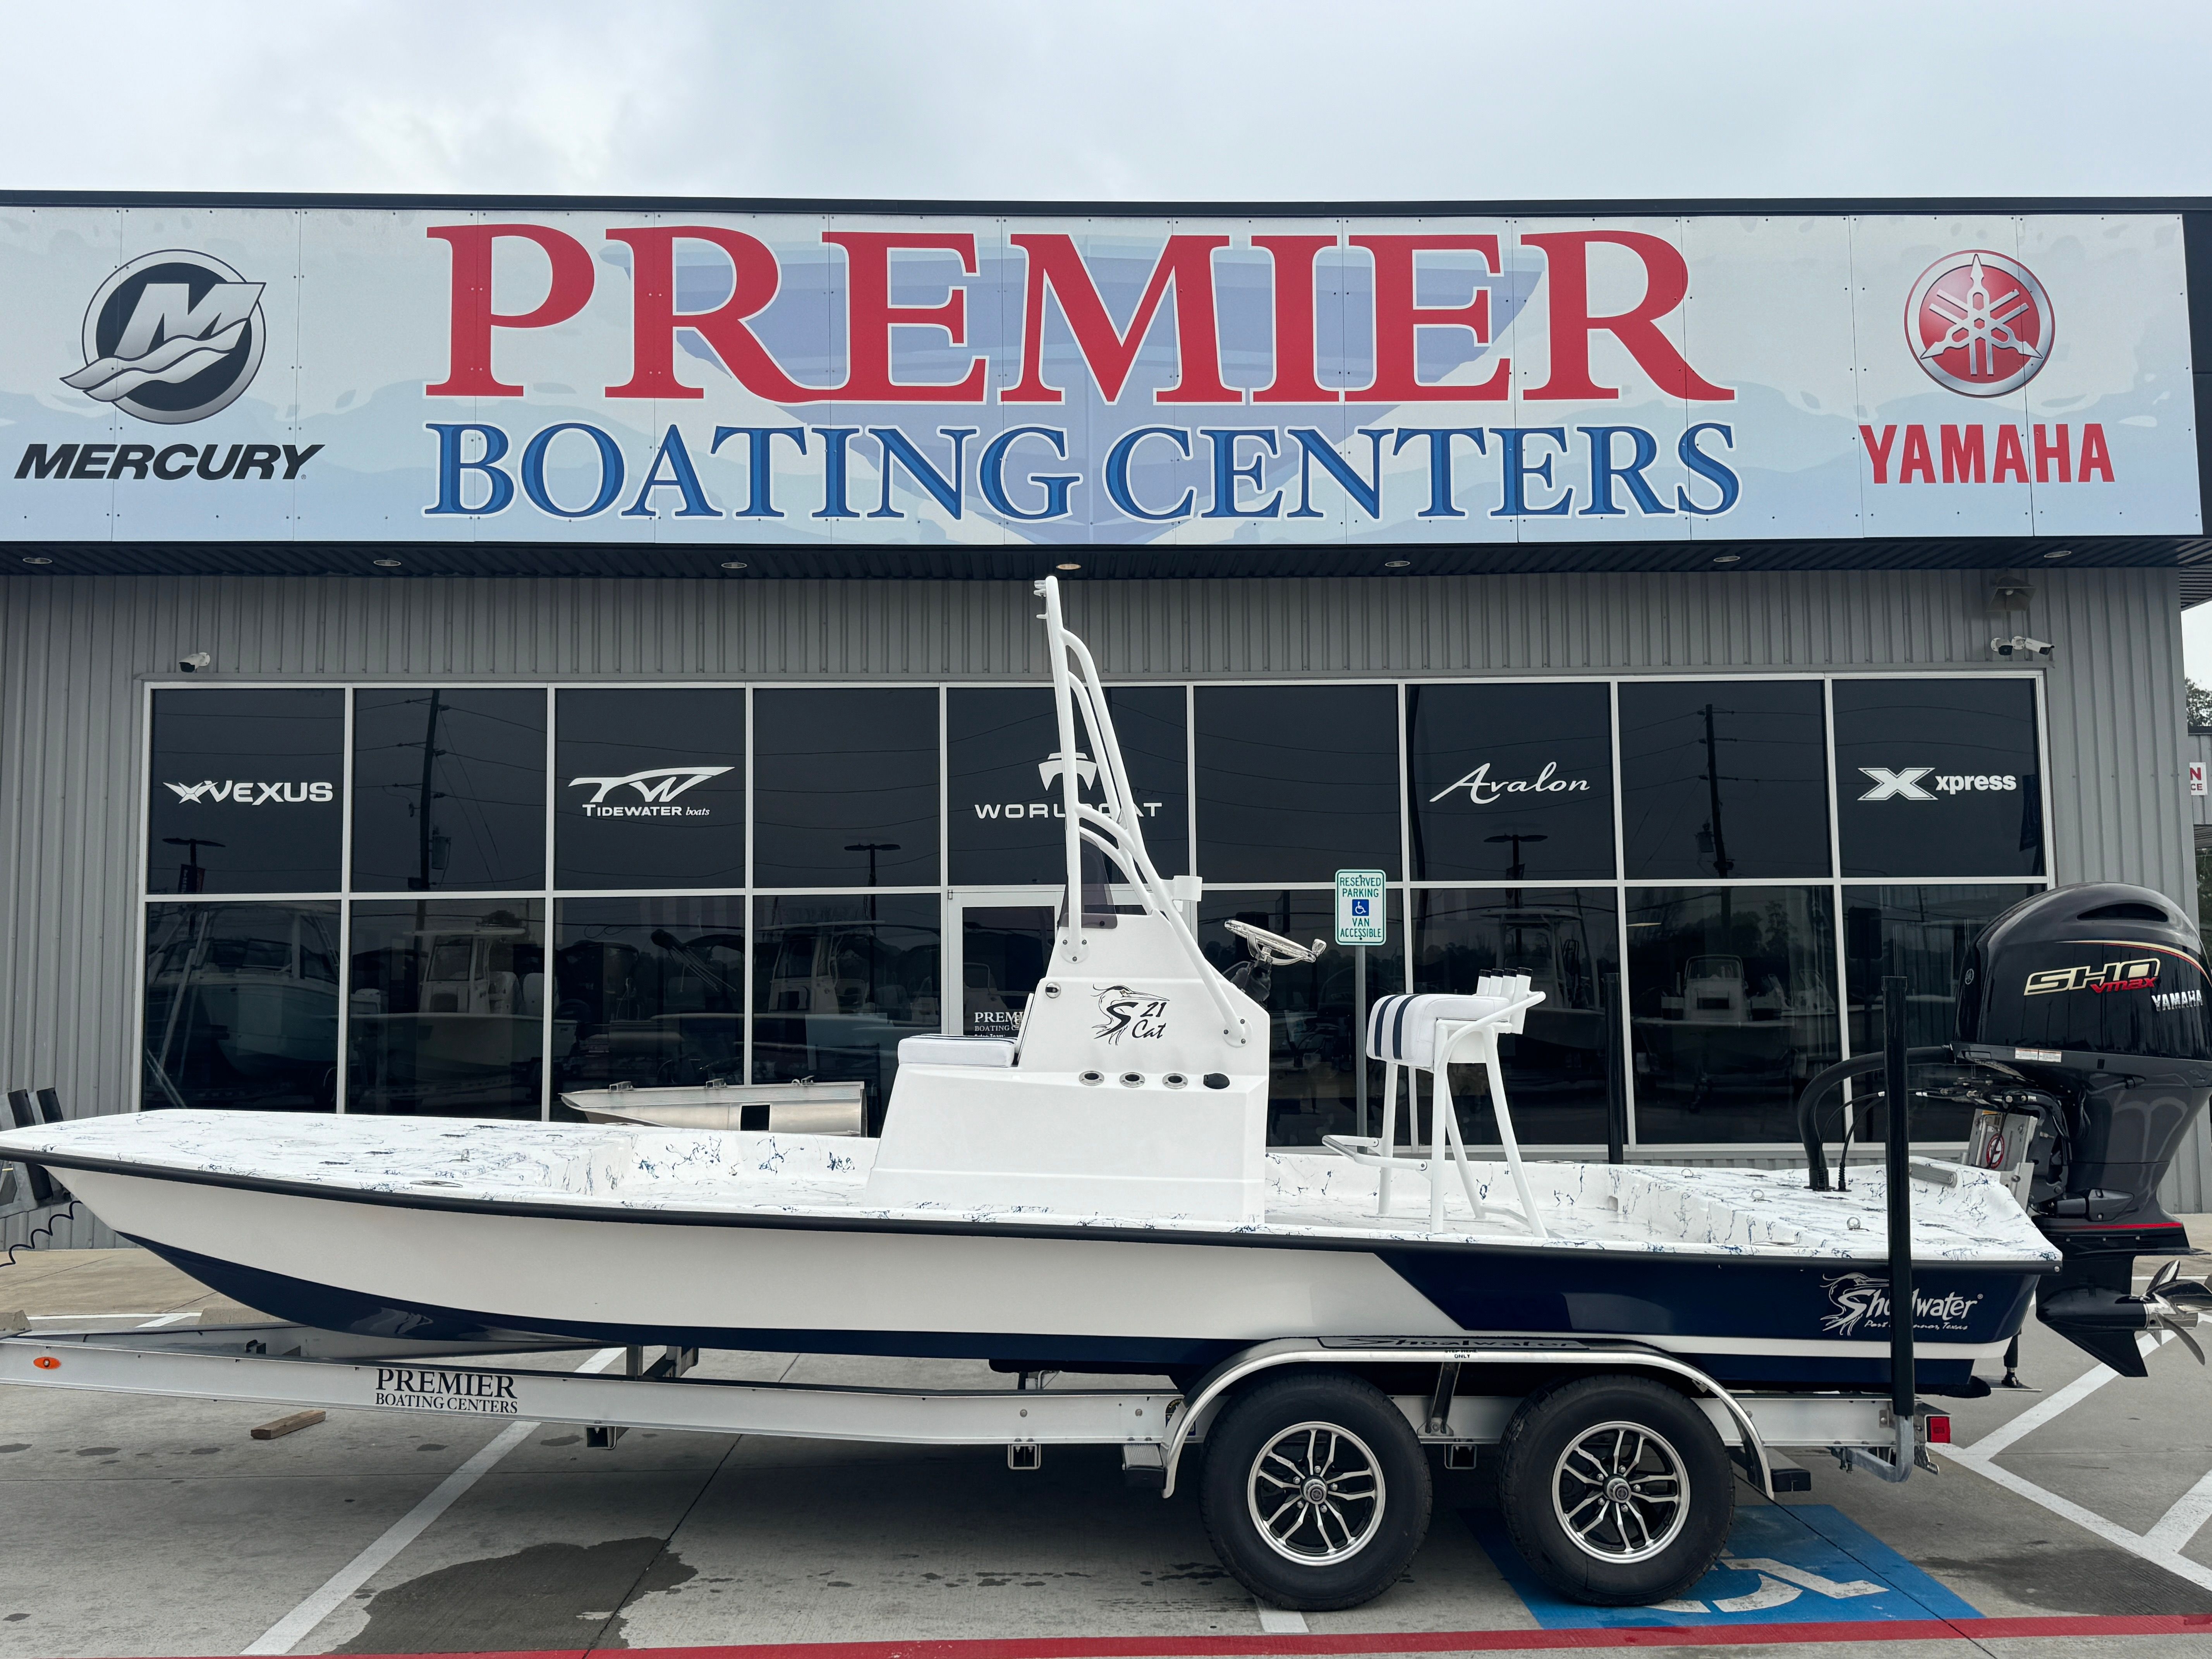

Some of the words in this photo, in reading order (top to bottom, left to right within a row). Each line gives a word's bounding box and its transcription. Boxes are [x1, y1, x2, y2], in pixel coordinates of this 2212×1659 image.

[426, 223, 1735, 403] PREMIER
[14, 443, 326, 480] MERCURY
[1859, 423, 2115, 483] YAMAHA
[424, 423, 1080, 520] BOATING
[1106, 422, 1740, 519] CENTERS
[204, 780, 333, 805] VEXUS
[1429, 761, 1590, 804] Avalon
[1936, 775, 2017, 795] xpress
[582, 804, 682, 817] TIDEWATER
[685, 806, 710, 816] boats
[1340, 877, 1381, 886] RESERVED
[1343, 888, 1379, 897] PARKING
[1340, 928, 1381, 937] ACCESSIBLE
[1352, 918, 1369, 927] VAN
[1140, 1002, 1167, 1017] 21
[2152, 989, 2203, 1012] YAMAHA
[1132, 1019, 1166, 1039] Cat
[1823, 1288, 1978, 1331] Sholwater
[375, 1368, 518, 1399] PREMIER
[375, 1393, 445, 1409] BOATING
[447, 1397, 518, 1414] CENTERS
